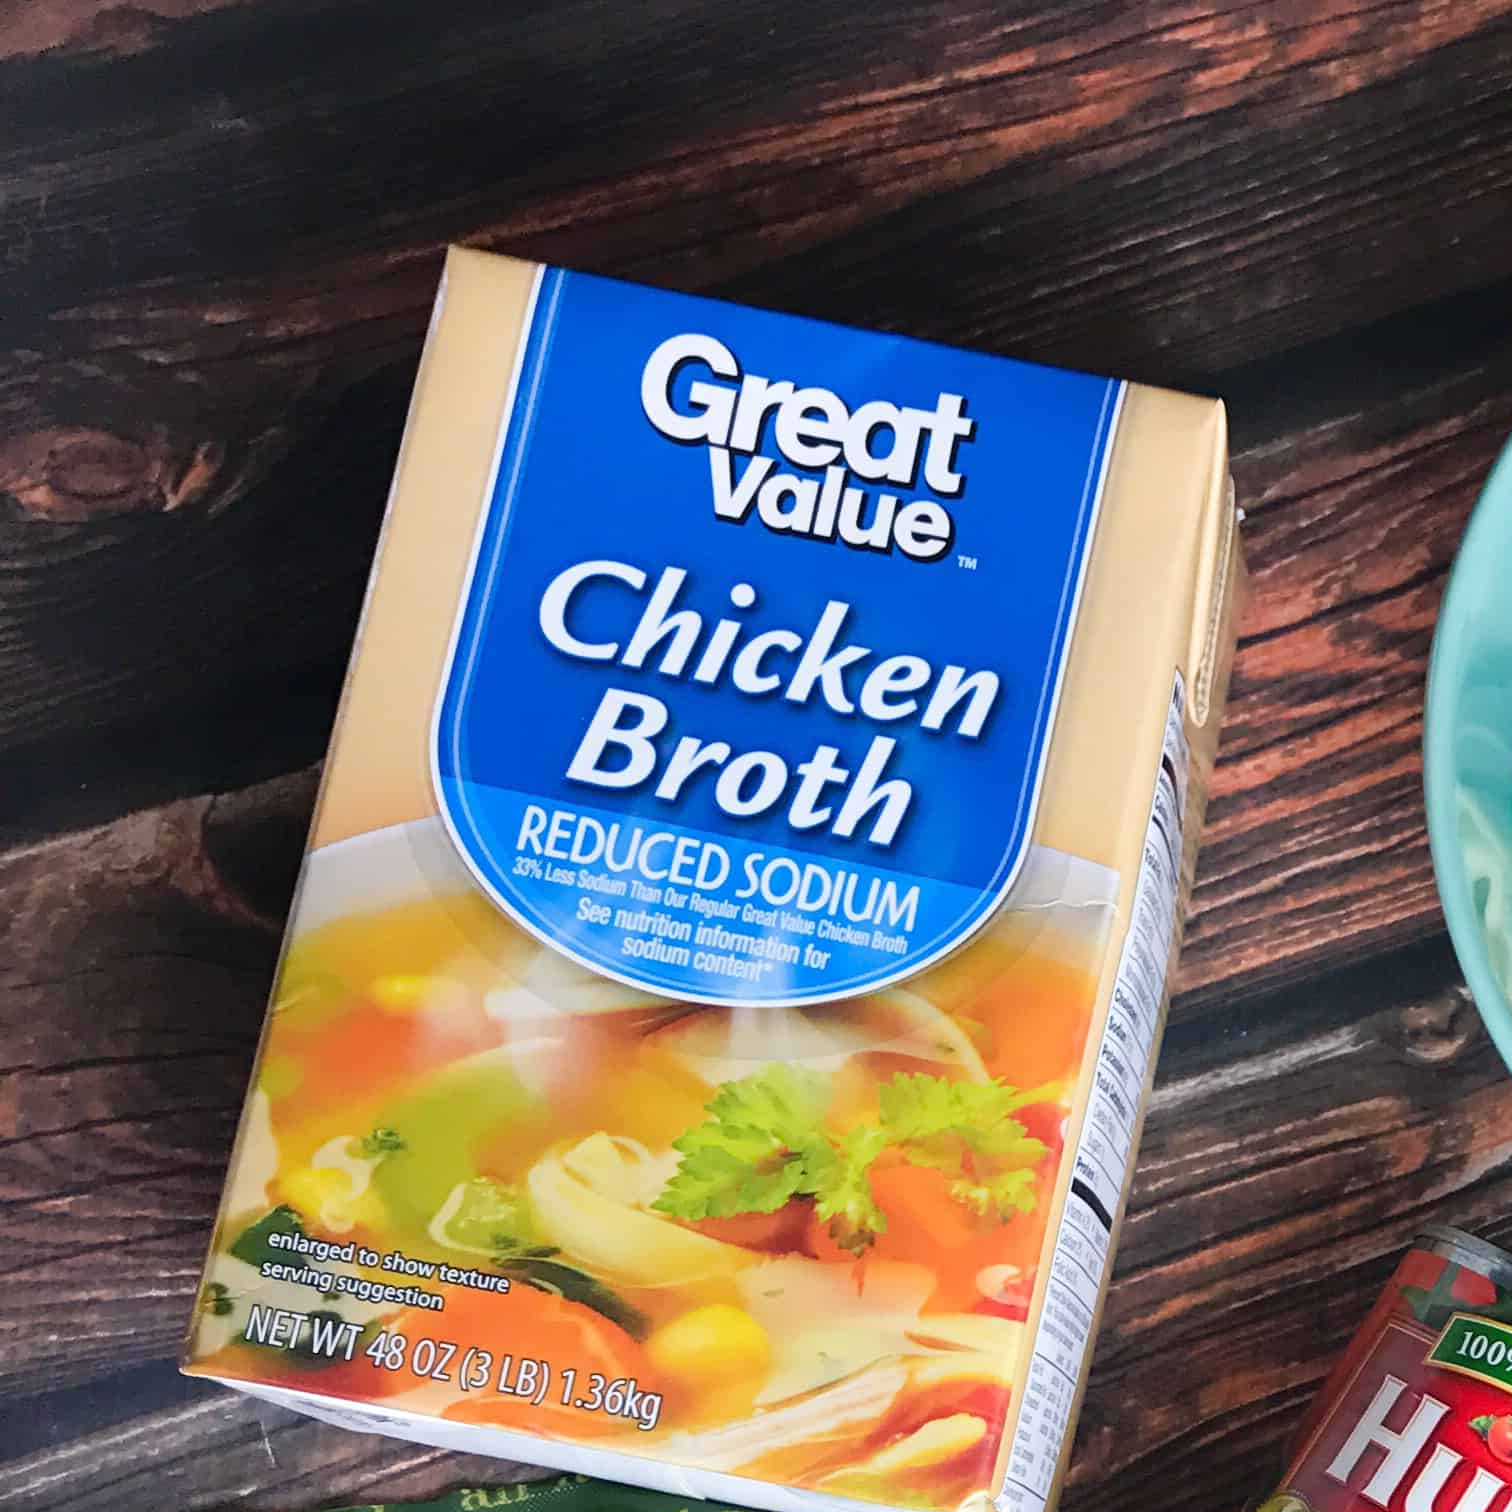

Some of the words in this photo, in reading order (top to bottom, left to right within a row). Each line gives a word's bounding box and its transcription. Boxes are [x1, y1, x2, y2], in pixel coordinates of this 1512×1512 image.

[640, 333, 975, 495] Great
[708, 445, 953, 559] Value
[539, 558, 1000, 738] Chicken
[565, 687, 913, 847] Broth
[512, 856, 542, 880] 33%
[544, 862, 576, 887] Less
[577, 869, 627, 897] Sodium
[630, 880, 661, 901] Than
[664, 887, 689, 908] Our
[689, 892, 741, 919] Regular
[742, 903, 777, 928] Great
[780, 911, 816, 936] Value
[817, 919, 870, 947] Chicken
[872, 931, 908, 955] Broth
[515, 805, 730, 890] REDUCED
[736, 853, 922, 933] SODIUM
[576, 897, 611, 926] See
[614, 907, 692, 942] nutrition
[694, 920, 800, 965] information
[803, 943, 831, 970] for
[621, 936, 690, 967] sodium
[261, 1258, 334, 1293] serving
[335, 1274, 444, 1312] suggestion
[268, 1229, 355, 1265] enlarged
[358, 1248, 378, 1267] to
[382, 1251, 435, 1282] show
[438, 1263, 510, 1294] texture
[244, 1305, 308, 1350] NET
[310, 1318, 365, 1362] WT
[365, 1336, 404, 1372] 48
[412, 1338, 459, 1383] OZ
[459, 1348, 494, 1392] (3
[498, 1358, 551, 1406] LB)
[559, 1367, 664, 1431] 1.36kg
